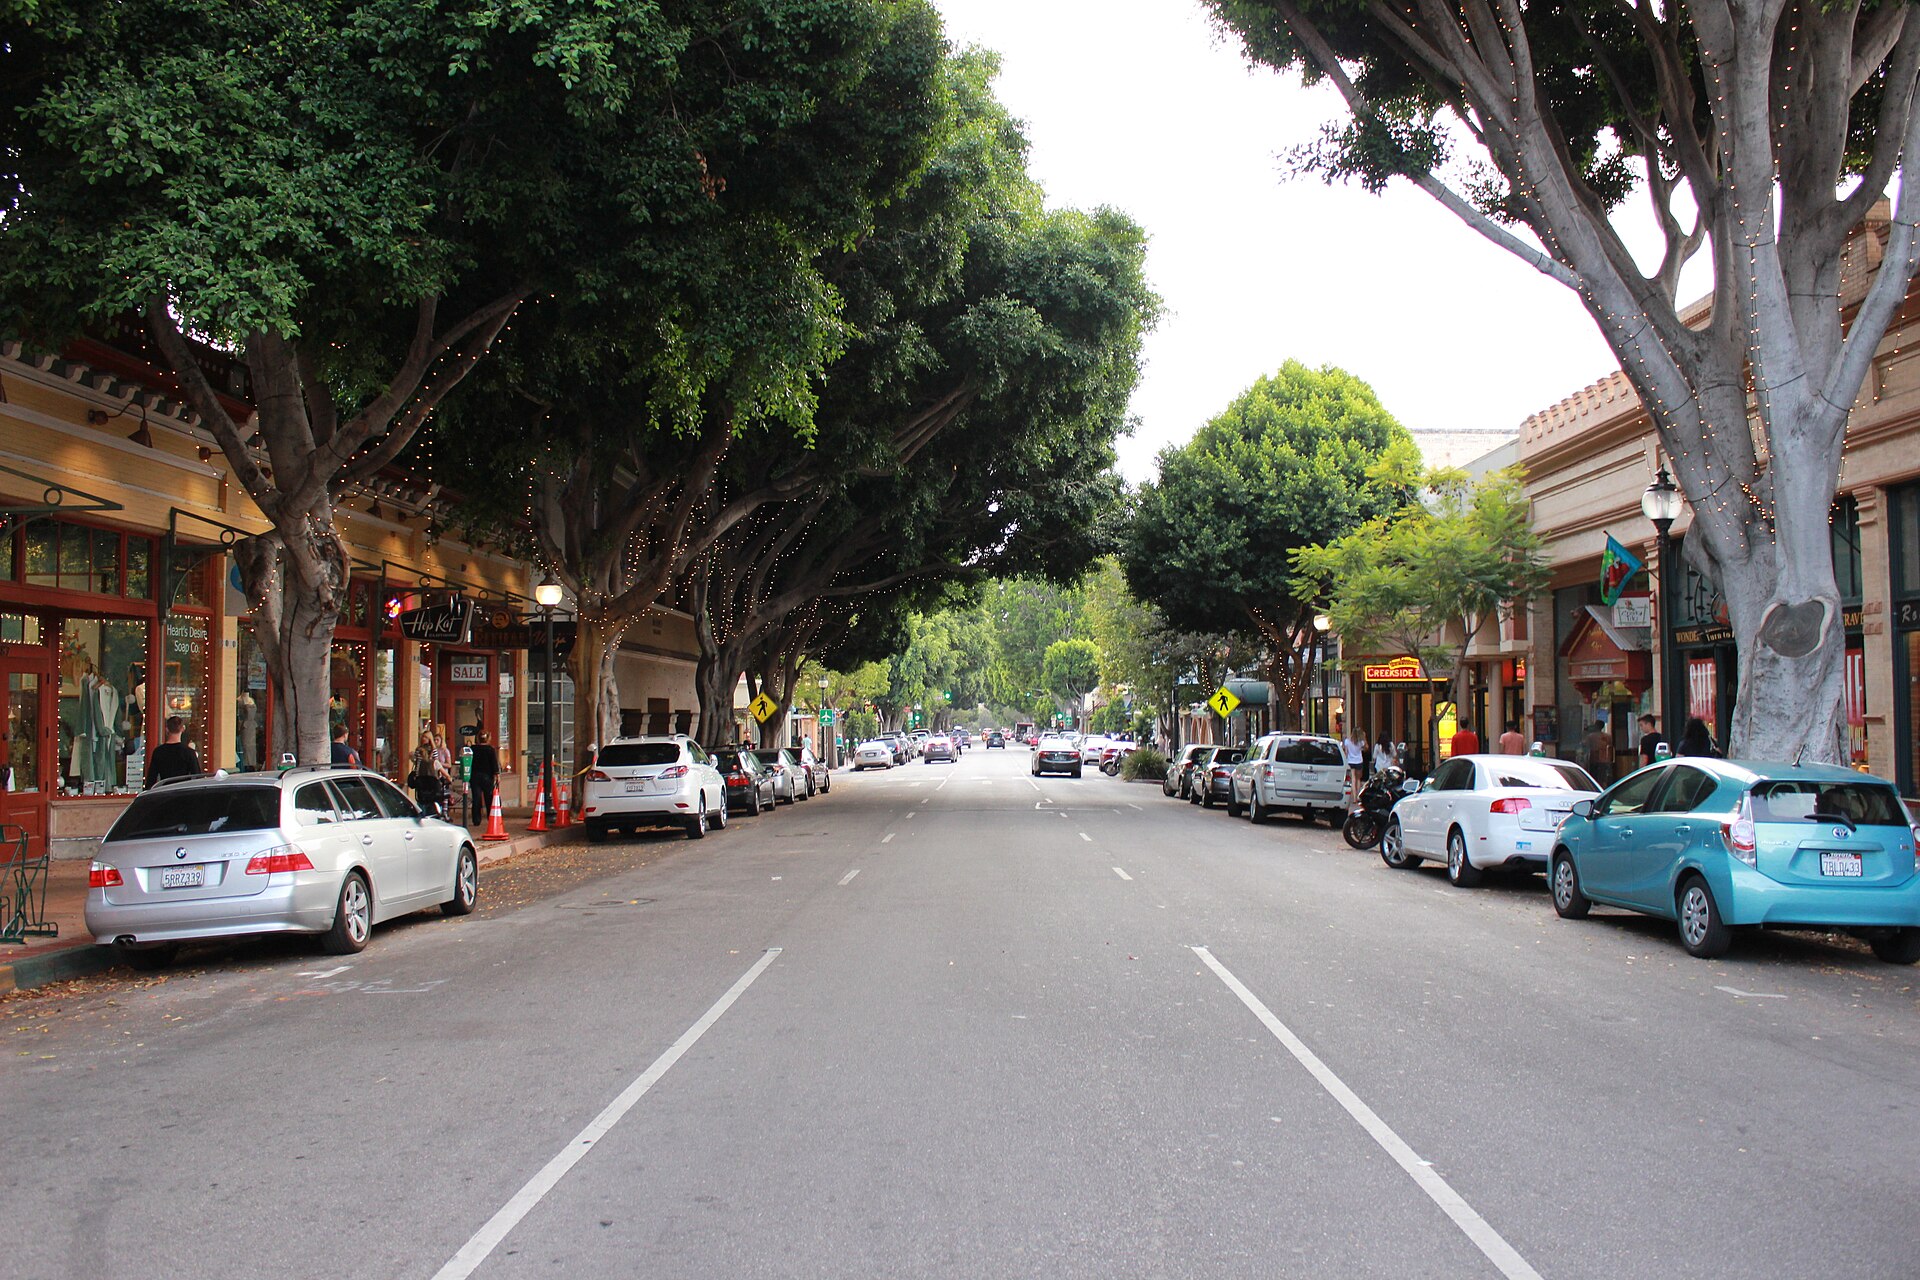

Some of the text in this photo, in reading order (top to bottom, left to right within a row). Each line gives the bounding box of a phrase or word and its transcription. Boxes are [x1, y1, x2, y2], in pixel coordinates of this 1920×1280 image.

[166, 624, 207, 639] Heart's Desire
[404, 611, 463, 637] Hep Kat
[174, 640, 200, 655] Soap Co.
[453, 666, 484, 679] SALE
[1367, 668, 1414, 678] CREEKSIDE
[1689, 663, 1713, 718] SALE
